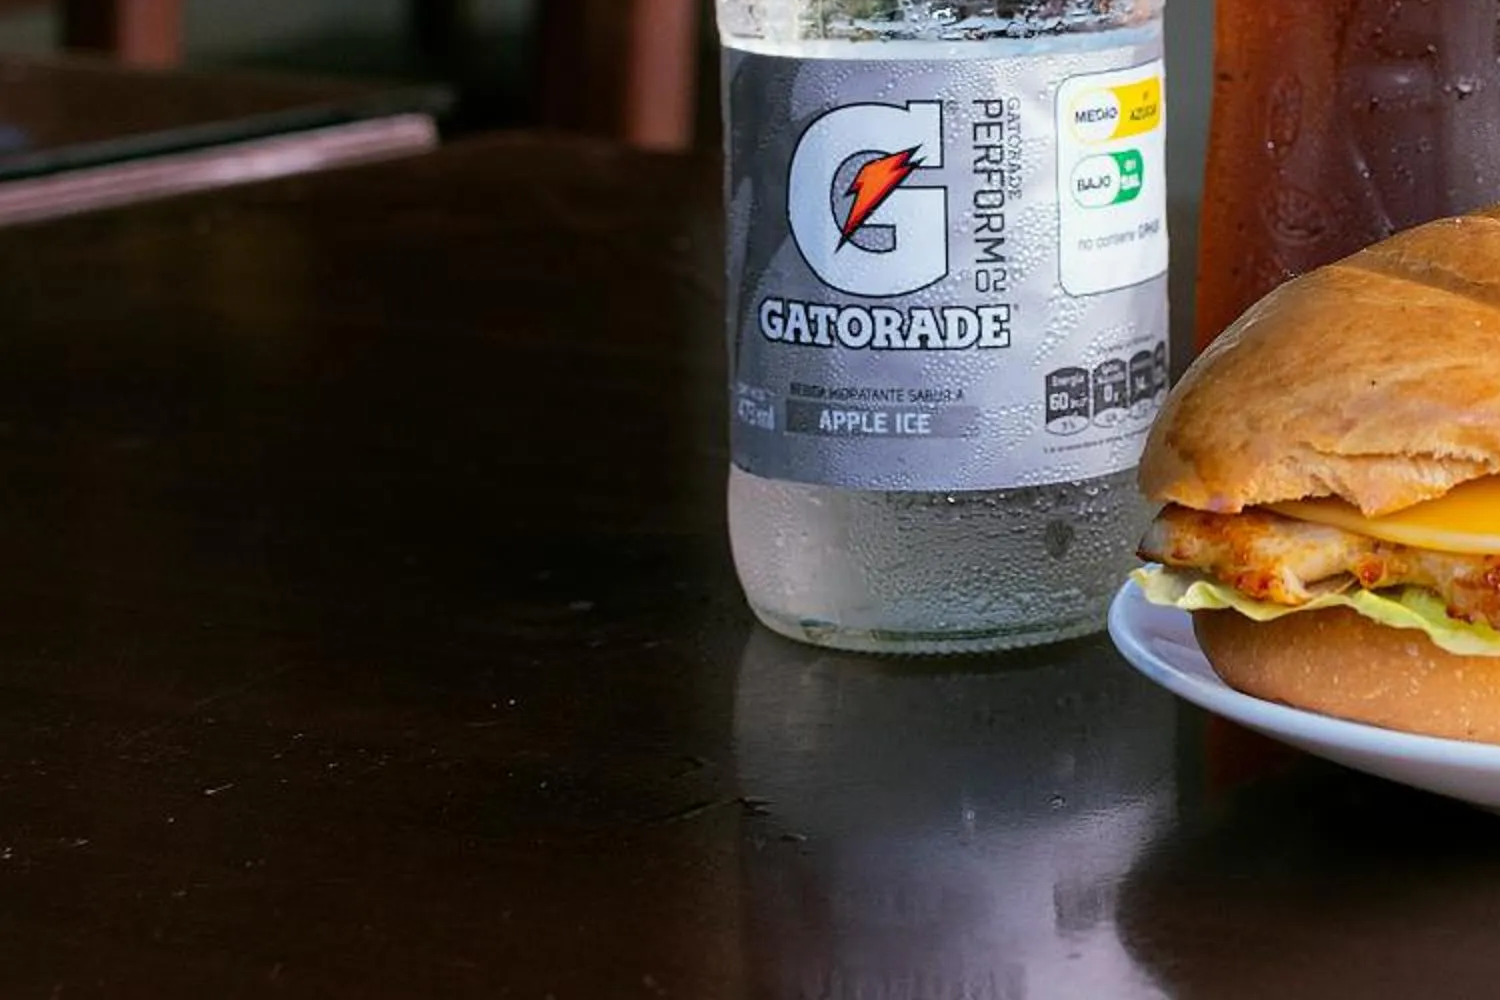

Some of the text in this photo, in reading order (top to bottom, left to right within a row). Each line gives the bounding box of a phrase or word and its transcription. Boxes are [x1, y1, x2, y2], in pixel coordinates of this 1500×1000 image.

[1075, 106, 1118, 124] MEDIO
[1006, 97, 1023, 201] GATORADE
[786, 100, 949, 299] G
[972, 98, 1006, 264] PERFORM
[1077, 174, 1111, 192] BAJO
[758, 299, 1011, 351] GATORADE
[819, 408, 932, 434] APPLE ICE
